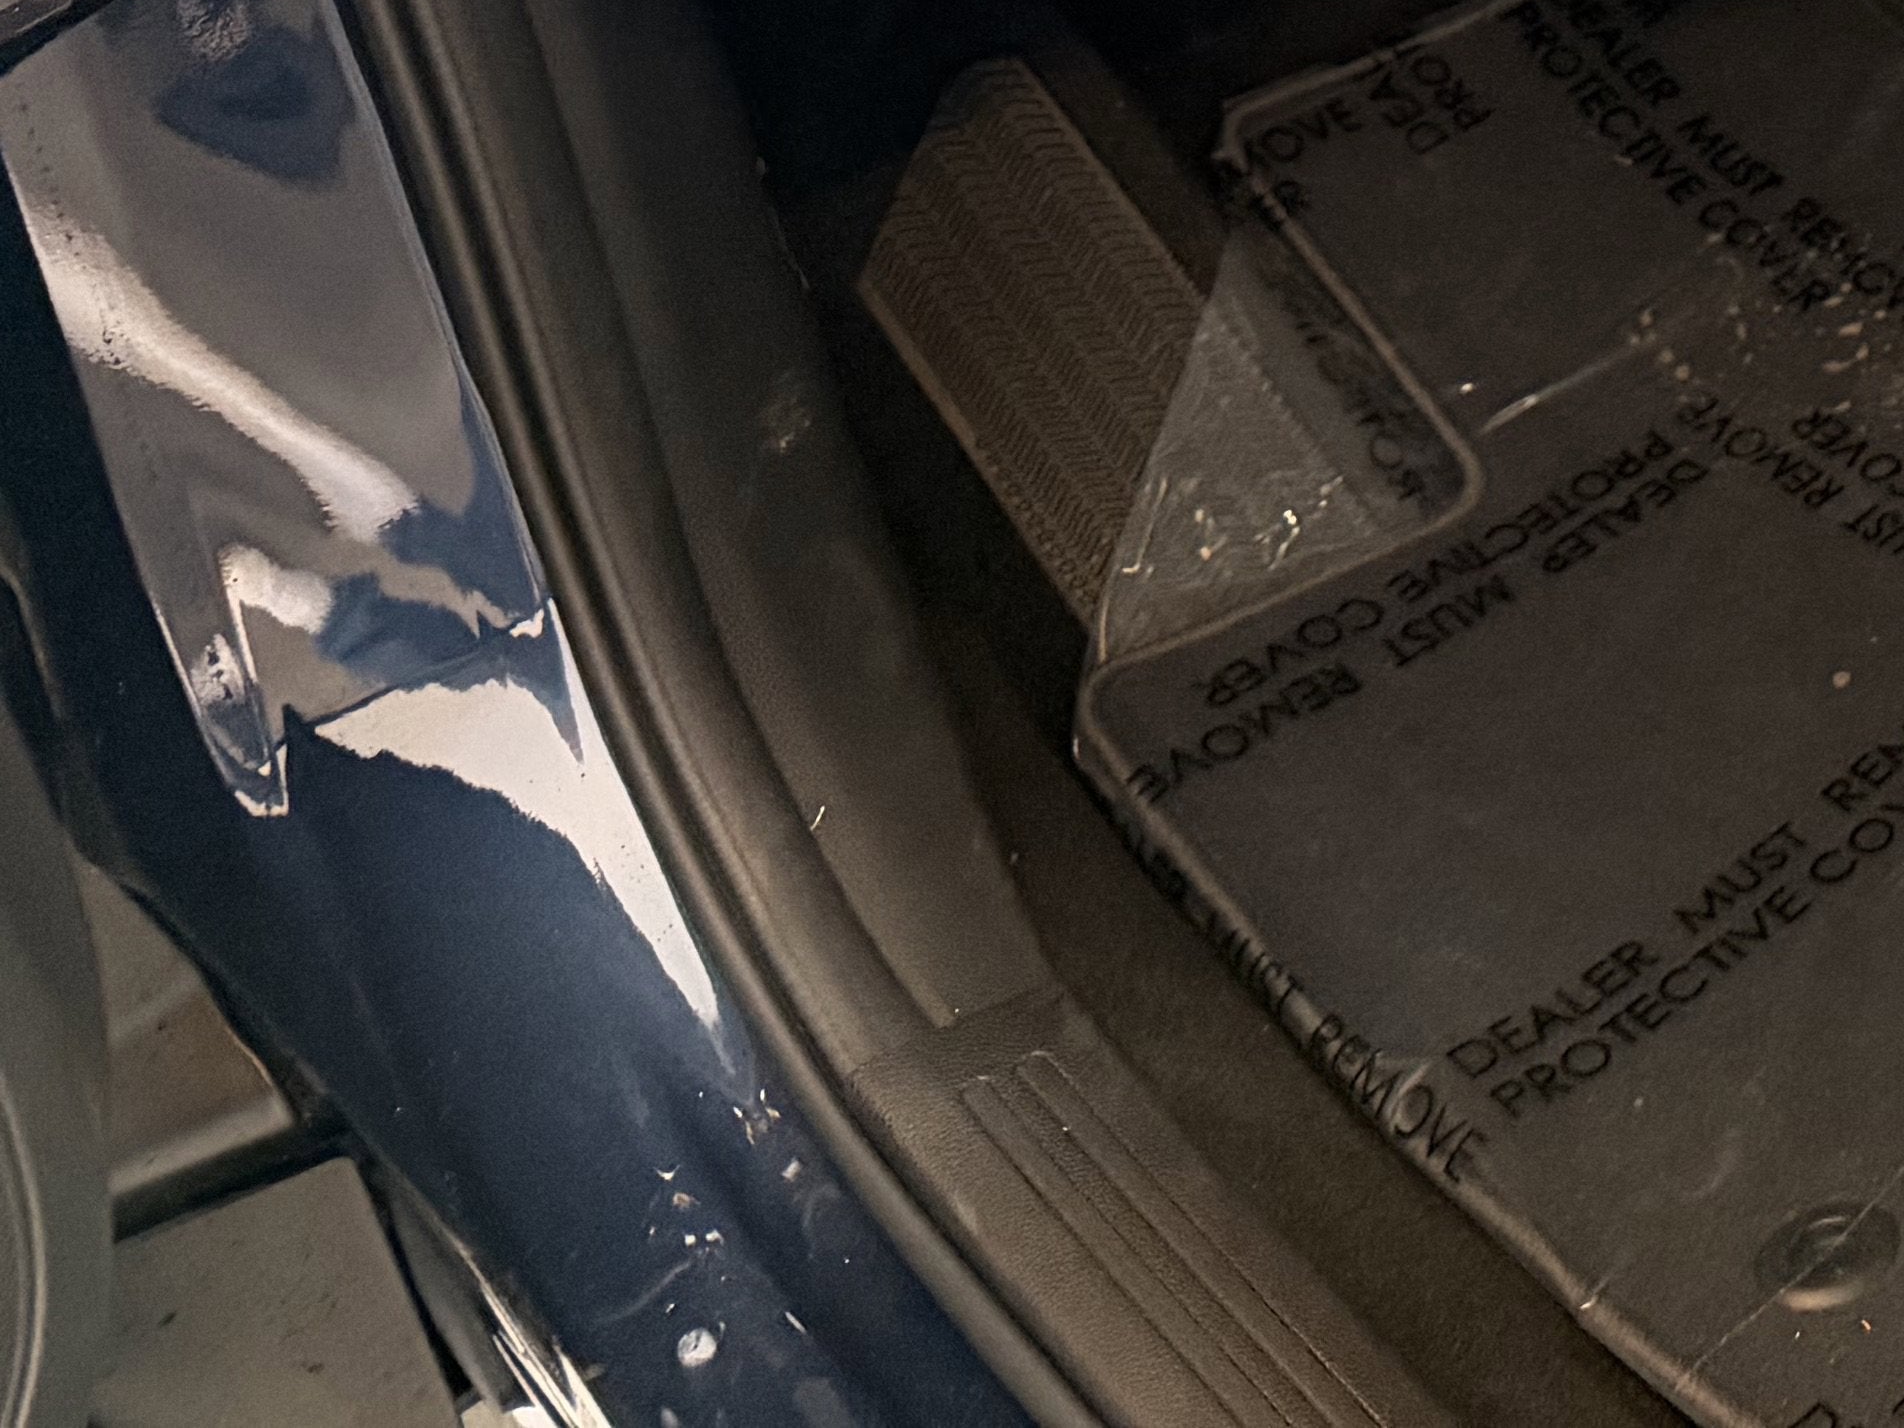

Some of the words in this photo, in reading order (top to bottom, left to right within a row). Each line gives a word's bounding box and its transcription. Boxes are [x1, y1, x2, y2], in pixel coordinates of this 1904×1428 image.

[1444, 938, 1662, 1080] DEALER
[1672, 818, 1808, 938] MUST
[1488, 878, 1814, 1122] PROTECTIVE
